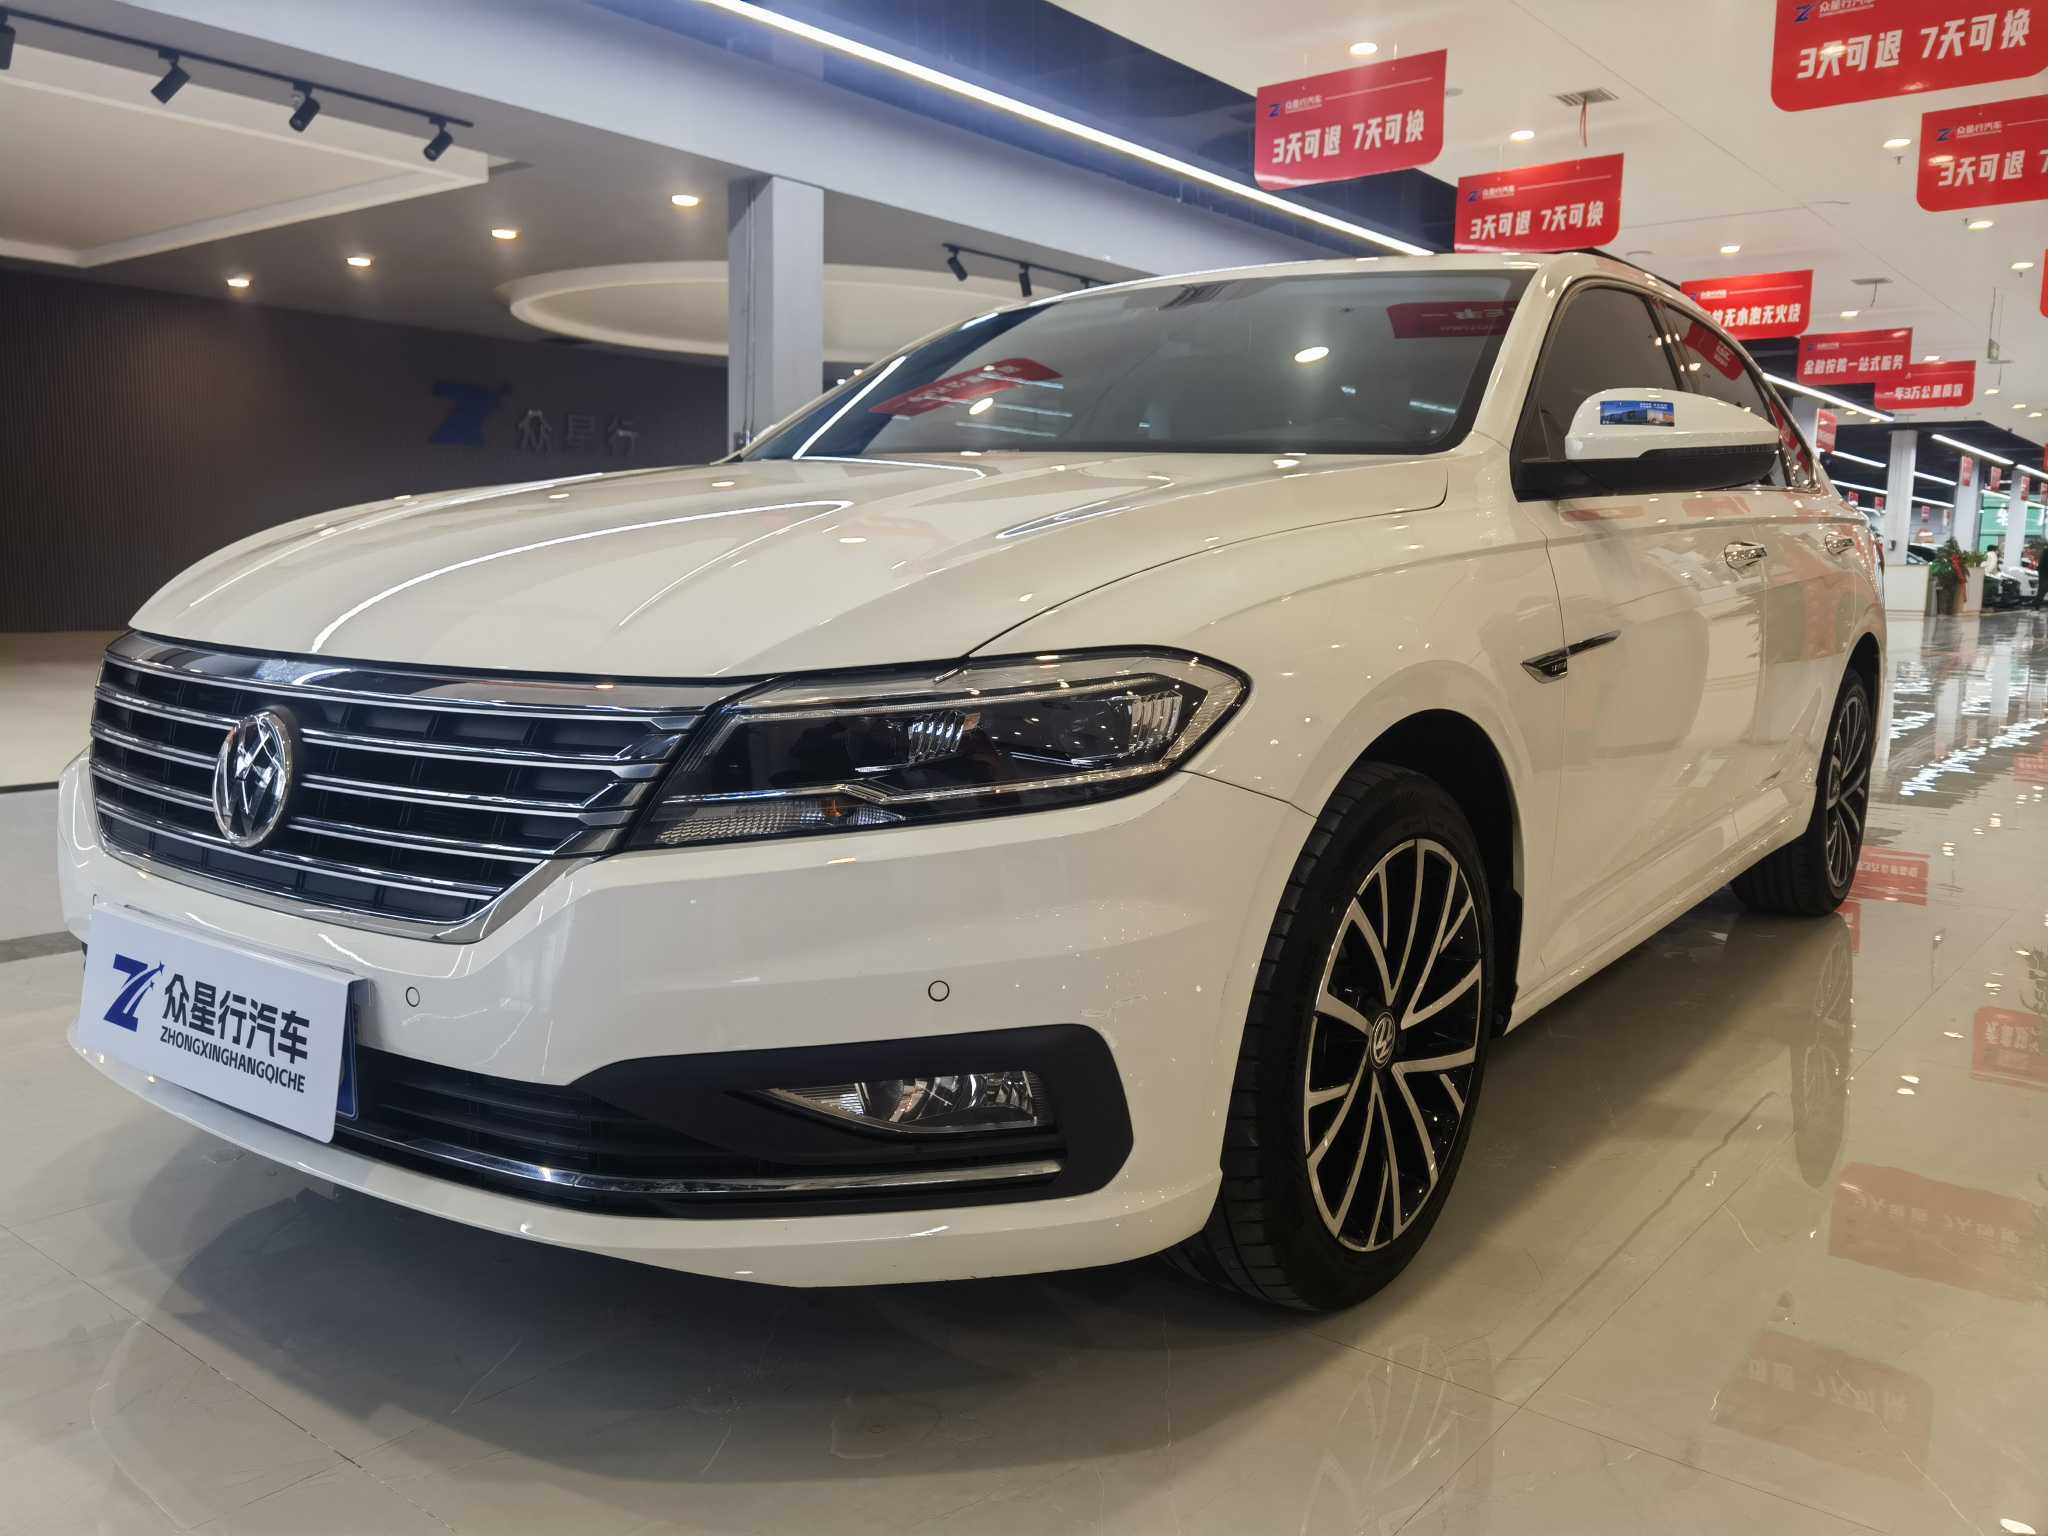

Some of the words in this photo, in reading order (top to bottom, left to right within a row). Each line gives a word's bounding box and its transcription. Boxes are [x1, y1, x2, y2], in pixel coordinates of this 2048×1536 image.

[1796, 29, 1903, 79] 3天可退
[1920, 8, 2031, 59] 7天可换
[1272, 124, 1341, 164] 3天可退
[1353, 110, 1425, 150] 7天可换
[1938, 150, 2026, 187] 3天可退
[1469, 210, 1532, 241] 3天可退
[1541, 200, 1604, 232] 7天可换
[162, 973, 310, 1065] 众星行汽车
[159, 1025, 306, 1094] ZHONGXINGHANGQICHE
